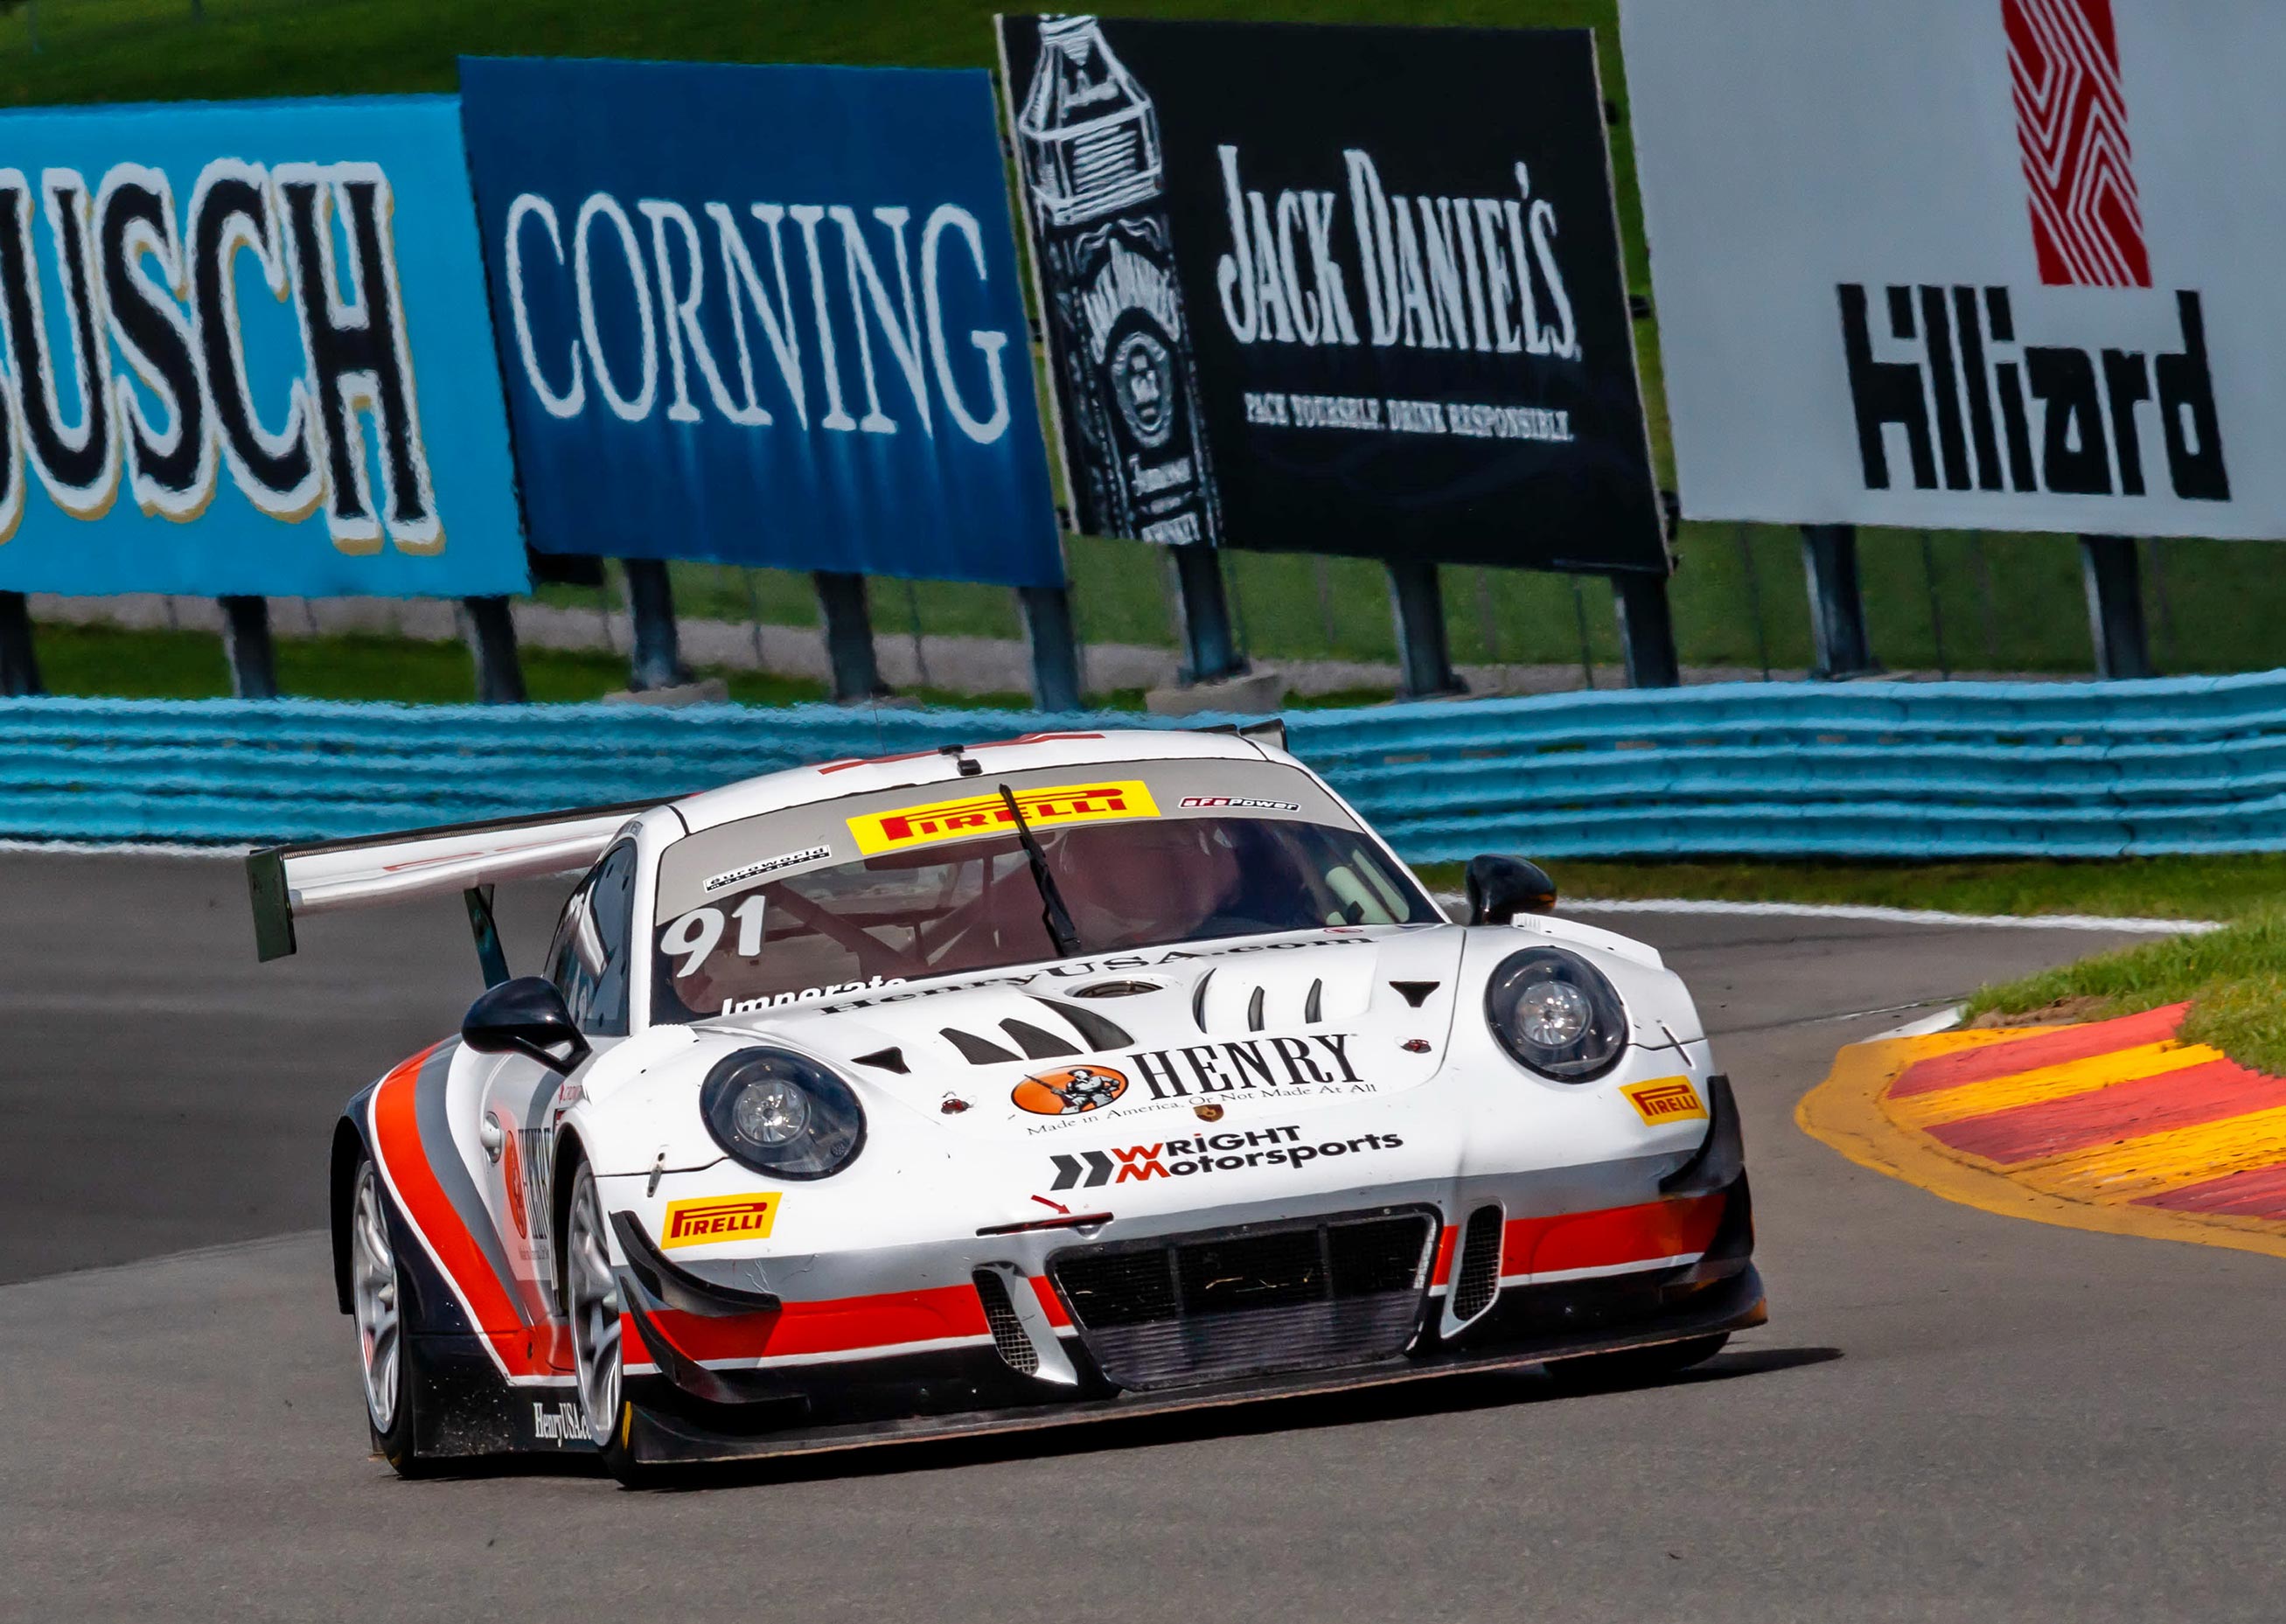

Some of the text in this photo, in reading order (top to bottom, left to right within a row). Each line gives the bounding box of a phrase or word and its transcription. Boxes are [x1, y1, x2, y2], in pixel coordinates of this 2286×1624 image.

[1217, 144, 1360, 346] JACK
[1343, 149, 1581, 361] DANIEL'S
[505, 192, 1011, 445] CORNING
[0, 160, 444, 554] USCH
[880, 788, 1126, 841] PIRELLI
[710, 847, 824, 885] euroworld
[660, 895, 765, 978] 91
[815, 937, 1379, 1014] HenryUSA.com
[1126, 1034, 1364, 1101] HENRY
[1027, 1120, 1077, 1136] Made
[1083, 1114, 1098, 1124] in
[1188, 1094, 1215, 1105] Or
[1221, 1092, 1253, 1102] Not
[1261, 1087, 1311, 1098] Made
[1319, 1084, 1342, 1094] At
[1350, 1084, 1377, 1093] All
[1631, 1084, 1699, 1116] PIRELLI
[1115, 1133, 1404, 1183] Motorsports
[670, 1202, 768, 1239] PIRELLI
